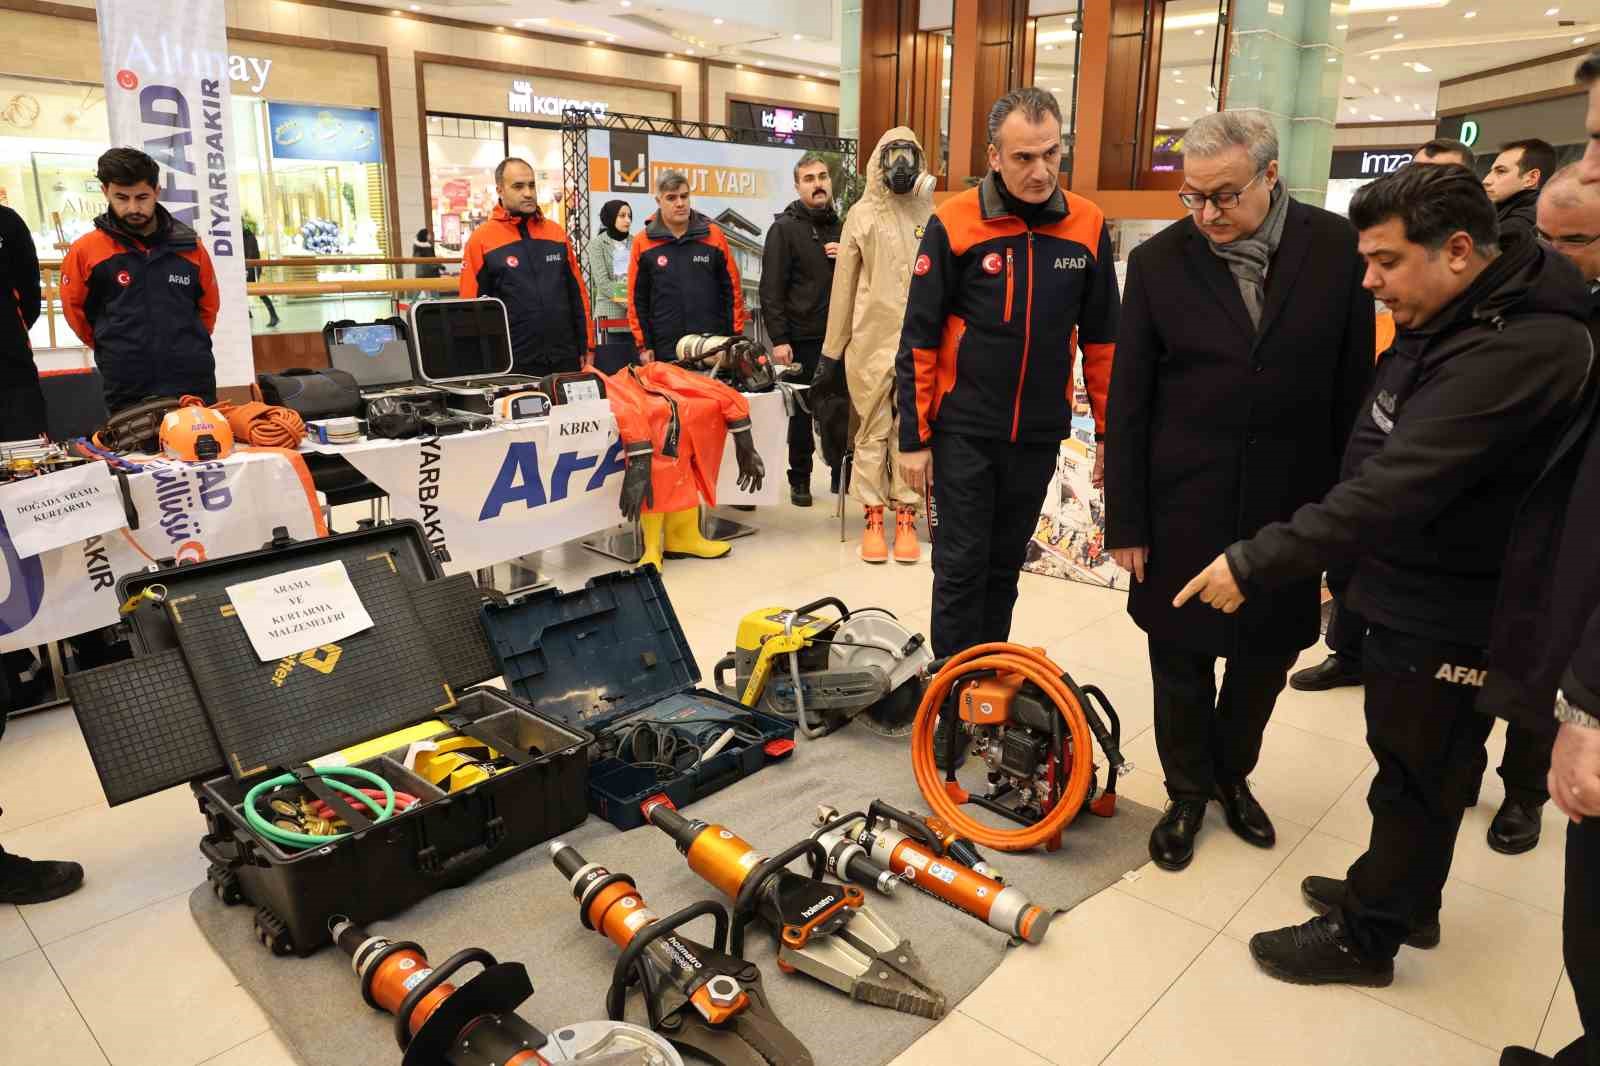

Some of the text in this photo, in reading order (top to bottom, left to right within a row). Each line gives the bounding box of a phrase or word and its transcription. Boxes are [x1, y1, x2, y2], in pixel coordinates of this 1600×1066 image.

[200, 78, 233, 257] DİYARBAKIR
[714, 168, 757, 194] YAPI
[1053, 256, 1087, 270] AFAD
[168, 273, 191, 286] AFAD
[559, 419, 601, 437] KBRN
[62, 486, 101, 503] ARAMA
[33, 500, 92, 522] KURTARMA
[272, 580, 311, 595] ARAMA
[288, 596, 304, 606] VE
[271, 603, 334, 626] KURTARMA
[800, 895, 835, 918] holmatro
[667, 936, 703, 969] holmatro
